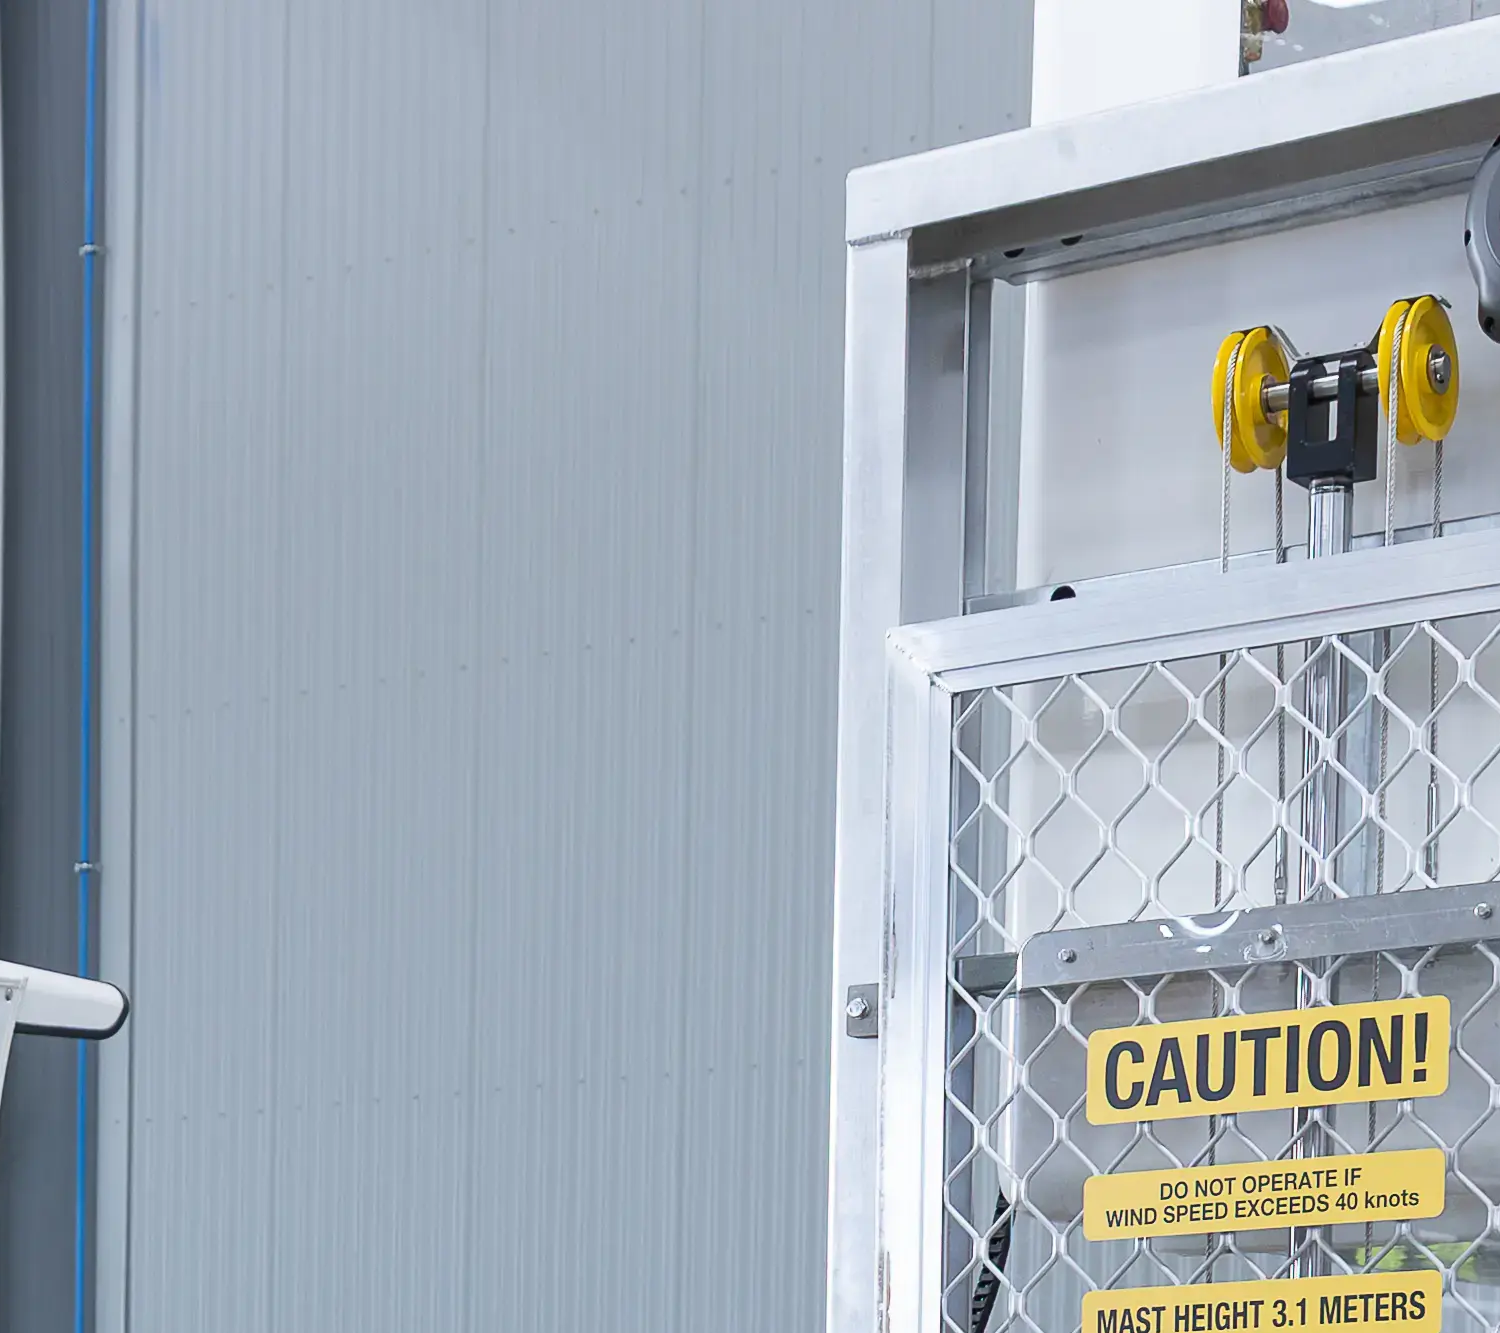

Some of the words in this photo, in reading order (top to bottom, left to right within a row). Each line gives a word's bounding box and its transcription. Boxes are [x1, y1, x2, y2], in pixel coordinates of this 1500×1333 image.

[1104, 1012, 1430, 1111] CAUTION!
[1159, 1182, 1189, 1201] DO
[1194, 1179, 1238, 1199] NOT
[1242, 1172, 1338, 1195] OPERATE
[1344, 1169, 1362, 1186] IF
[1106, 1204, 1158, 1228] WIND
[1162, 1201, 1229, 1224] SPEED
[1234, 1194, 1331, 1220] EXCEEDS
[1336, 1191, 1359, 1211] 40
[1364, 1189, 1420, 1210] knots
[1173, 1300, 1264, 1332] HEIGHT
[1272, 1298, 1309, 1328] 3.1
[1319, 1291, 1426, 1325] METERS
